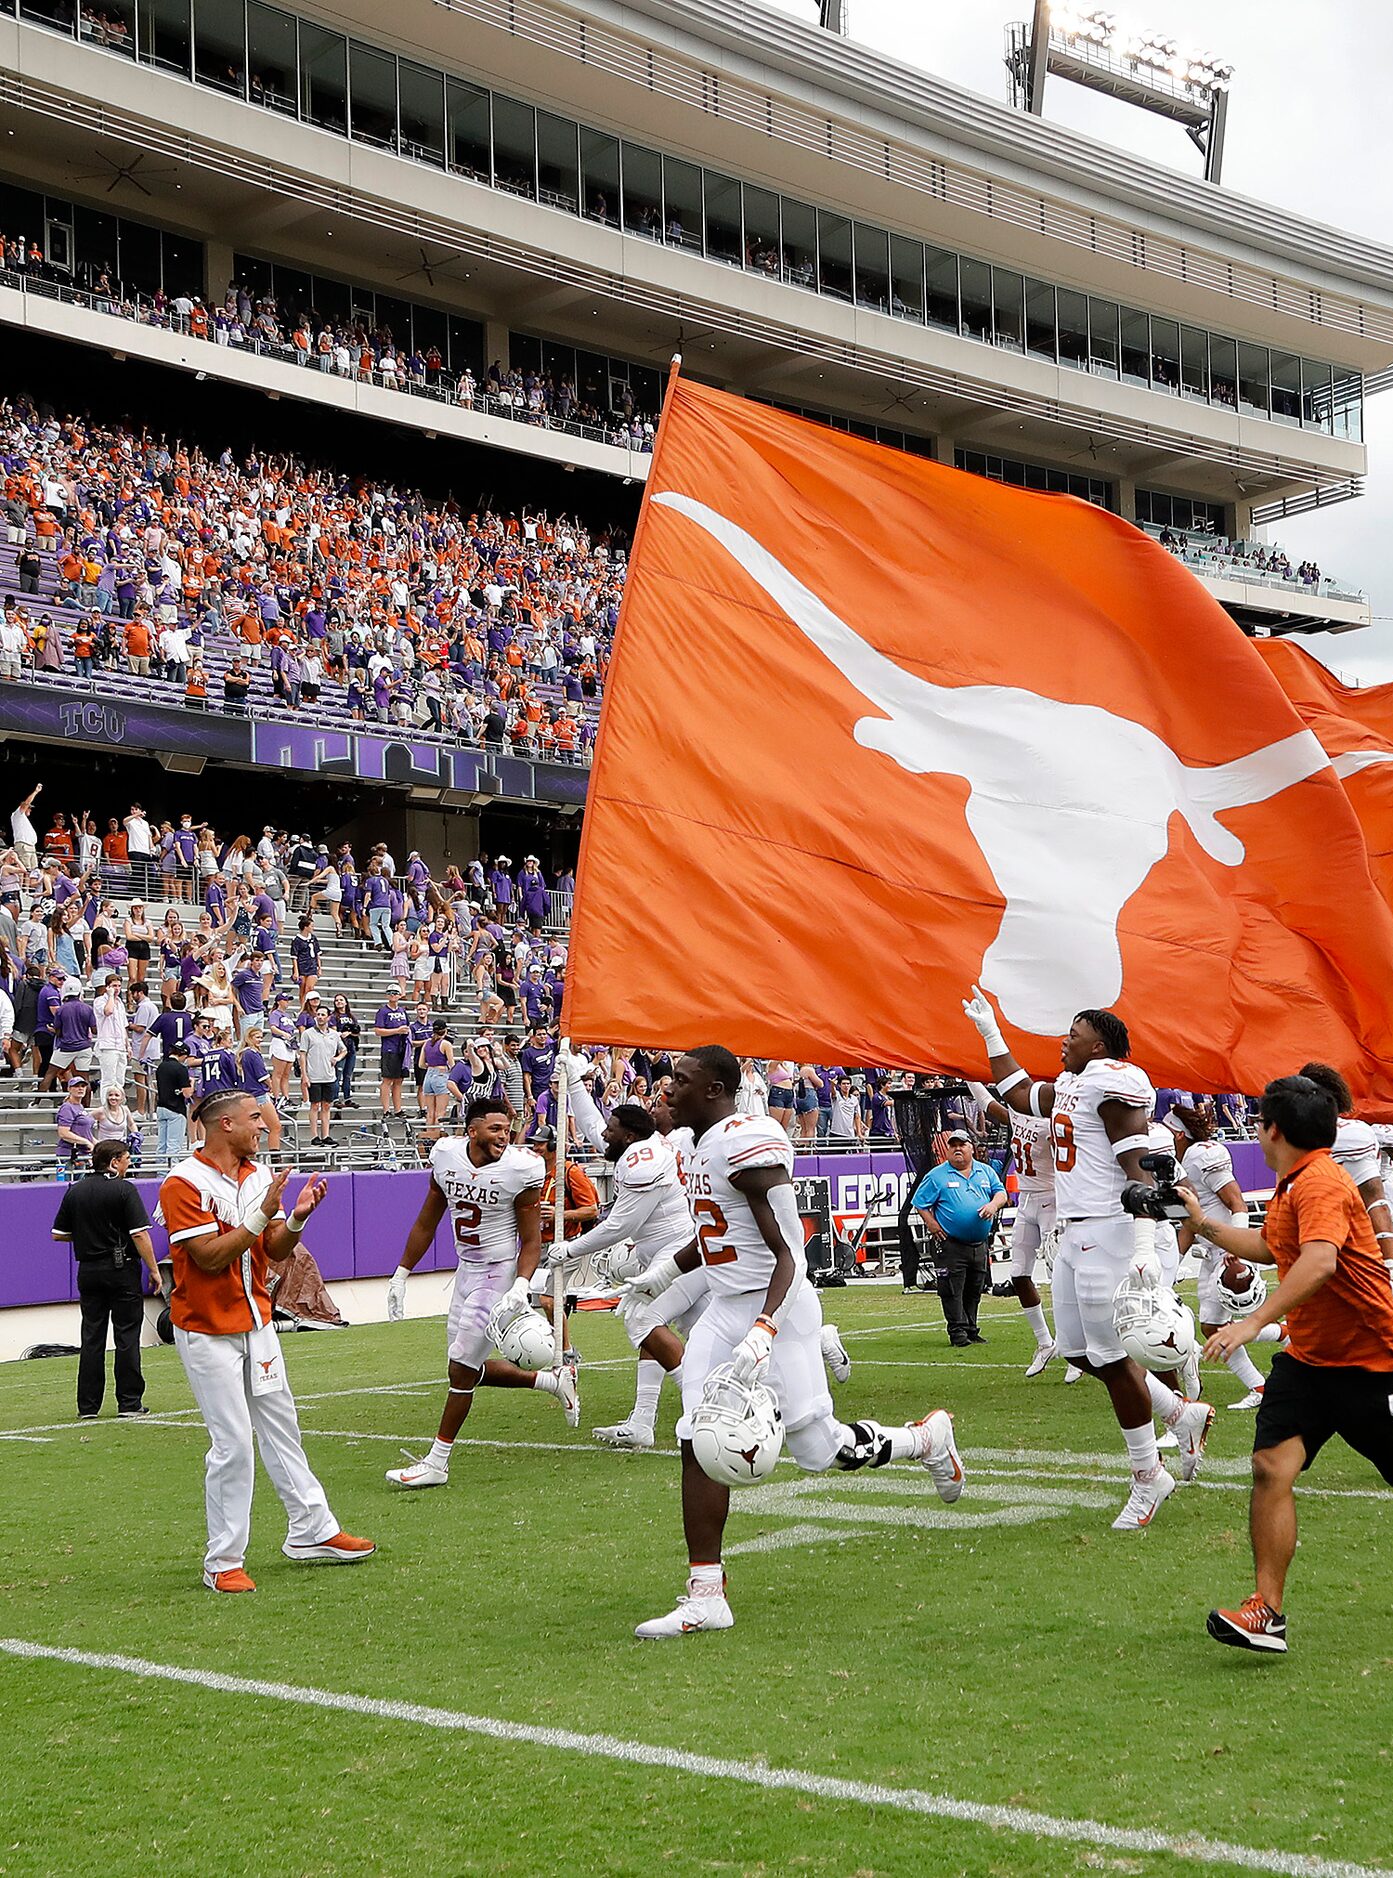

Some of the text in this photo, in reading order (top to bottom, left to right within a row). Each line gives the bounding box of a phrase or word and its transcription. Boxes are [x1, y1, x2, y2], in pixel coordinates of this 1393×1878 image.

[59, 702, 127, 743] TCU
[90, 843, 99, 857] 8
[176, 1018, 184, 1038] 1
[204, 1062, 222, 1081] 14
[1012, 1121, 1039, 1143] TEXAS
[626, 1147, 654, 1168] 99
[445, 1180, 499, 1205] TEXAS
[455, 1199, 482, 1246] 2
[694, 1198, 738, 1266] 2
